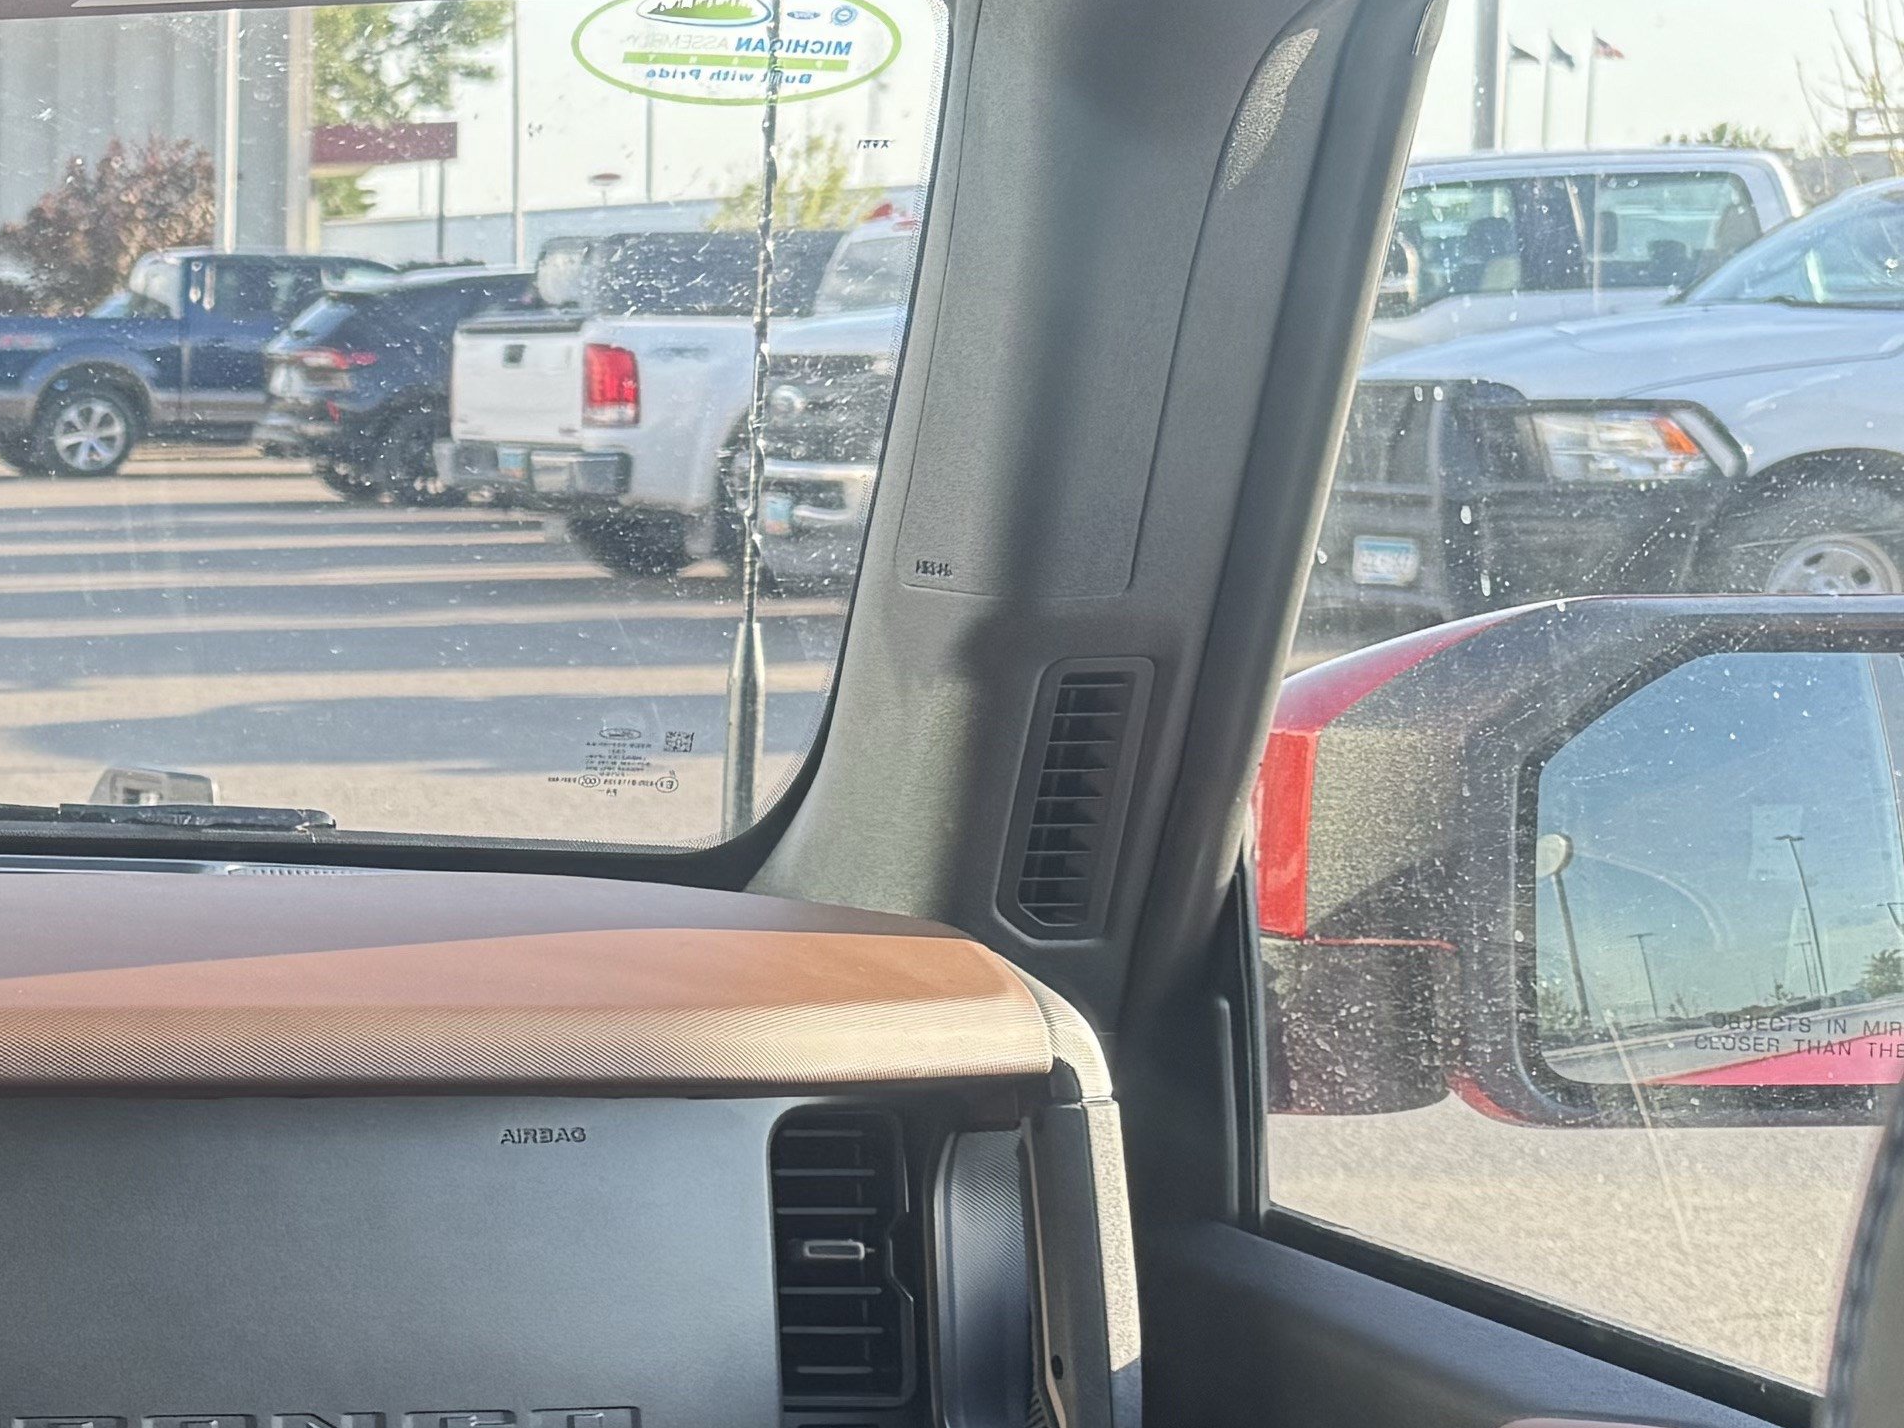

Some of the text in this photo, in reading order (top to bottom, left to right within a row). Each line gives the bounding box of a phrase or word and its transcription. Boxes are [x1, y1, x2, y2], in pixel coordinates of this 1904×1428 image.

[1712, 1013, 1812, 1033] OBJECTS
[1827, 1019, 1847, 1034] IN
[1694, 1036, 1780, 1053] CLOSER
[1794, 1038, 1852, 1056] THAN
[500, 1127, 587, 1145] AIRBAG
